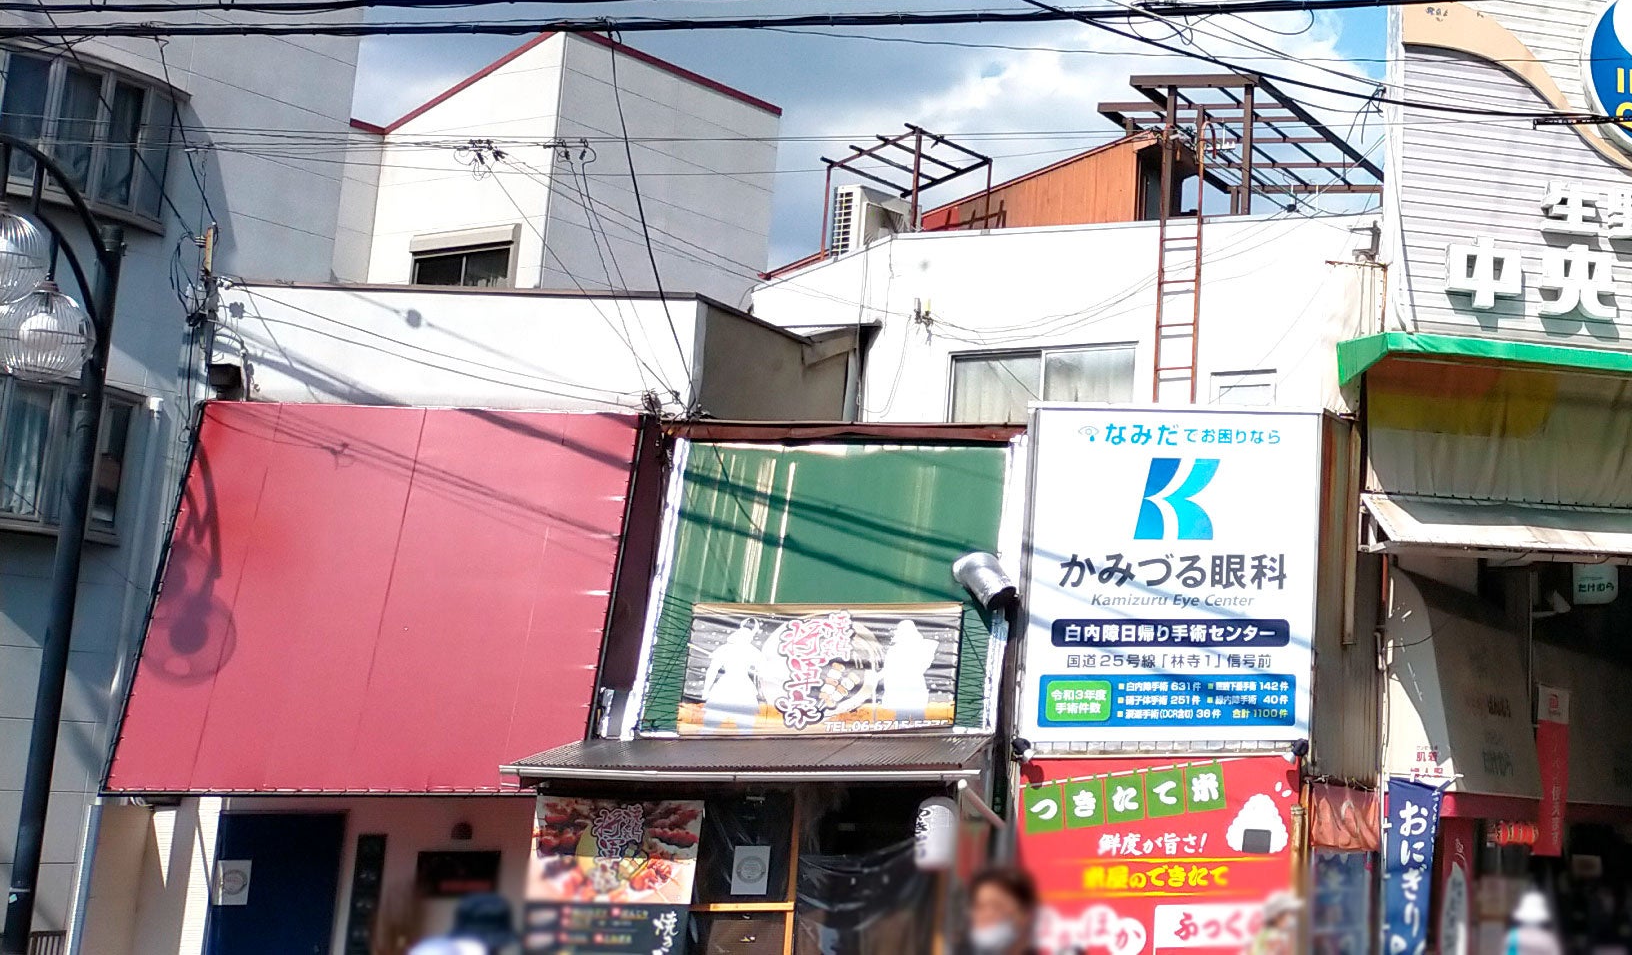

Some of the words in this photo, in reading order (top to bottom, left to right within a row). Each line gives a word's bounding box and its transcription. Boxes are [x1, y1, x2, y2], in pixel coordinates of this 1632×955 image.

[1059, 553, 1288, 590] かみづる眼科
[1091, 594, 1167, 606] Kamizuru
[1173, 594, 1199, 608] Eye
[1205, 594, 1256, 606] Center
[1064, 624, 1276, 642] 白内障日帰り手術センター
[1398, 800, 1429, 937] おにぎり
